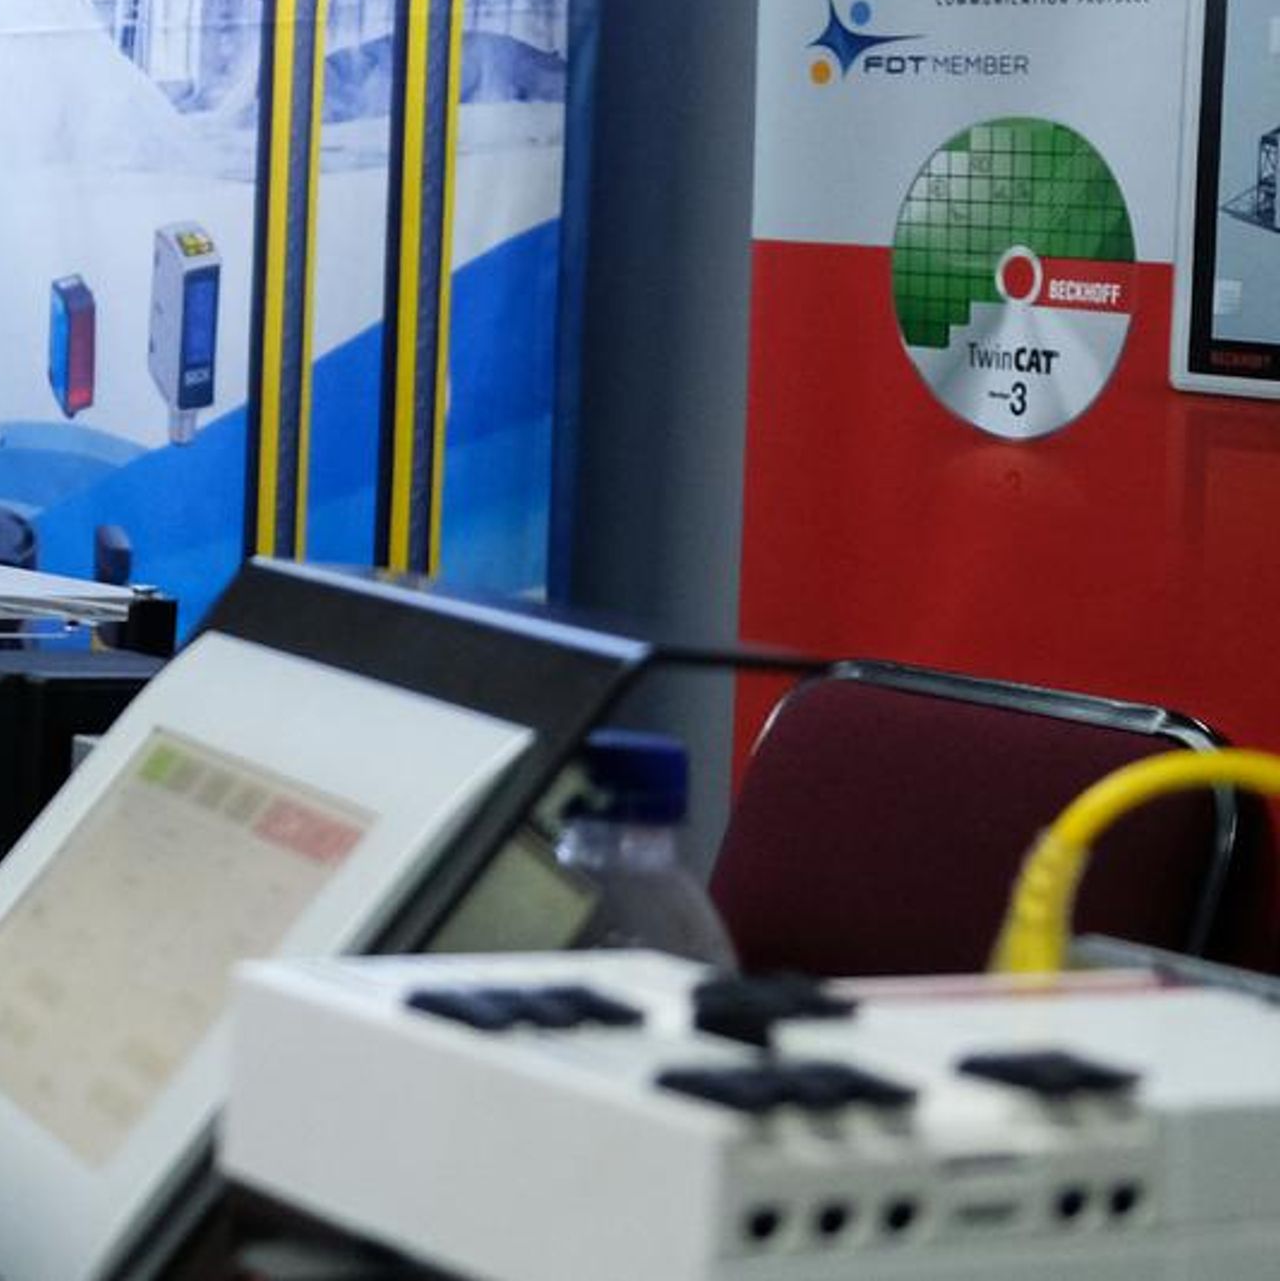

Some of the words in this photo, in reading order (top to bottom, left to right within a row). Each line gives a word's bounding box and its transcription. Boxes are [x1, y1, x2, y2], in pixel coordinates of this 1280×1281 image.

[863, 55, 927, 75] FDT
[932, 55, 1030, 76] MEMBER
[1049, 278, 1122, 305] BECKHOFF
[1009, 380, 1028, 417] 3
